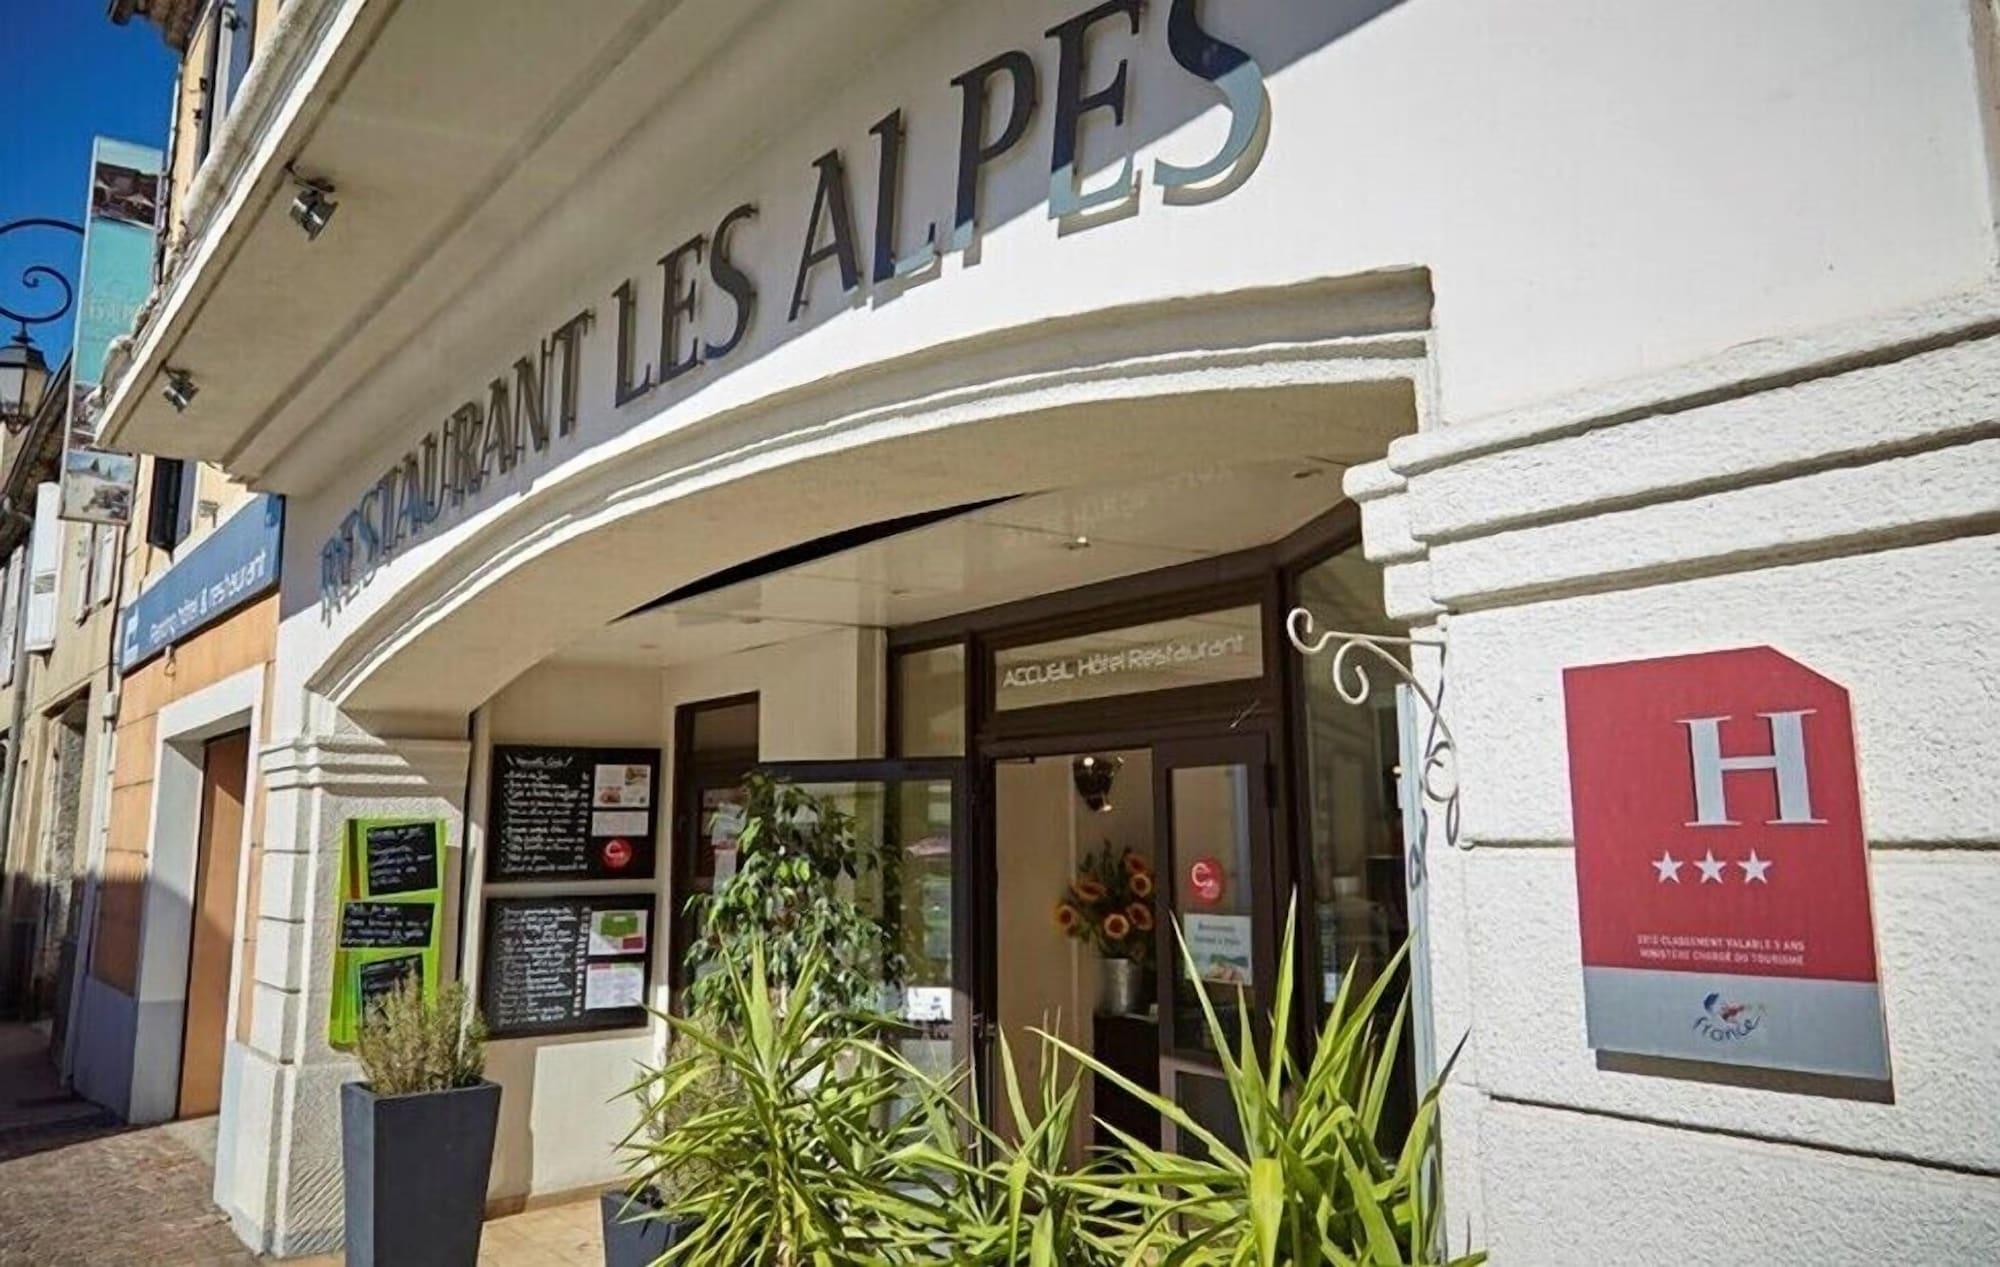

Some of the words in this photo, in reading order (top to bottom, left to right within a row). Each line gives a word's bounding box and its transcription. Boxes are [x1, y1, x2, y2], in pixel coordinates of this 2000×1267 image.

[321, 309, 594, 622] RESTAURANT
[606, 203, 758, 407] LES
[788, 0, 1266, 321] ALPES
[1129, 634, 1245, 669] Restaurant
[1676, 709, 1829, 827] H
